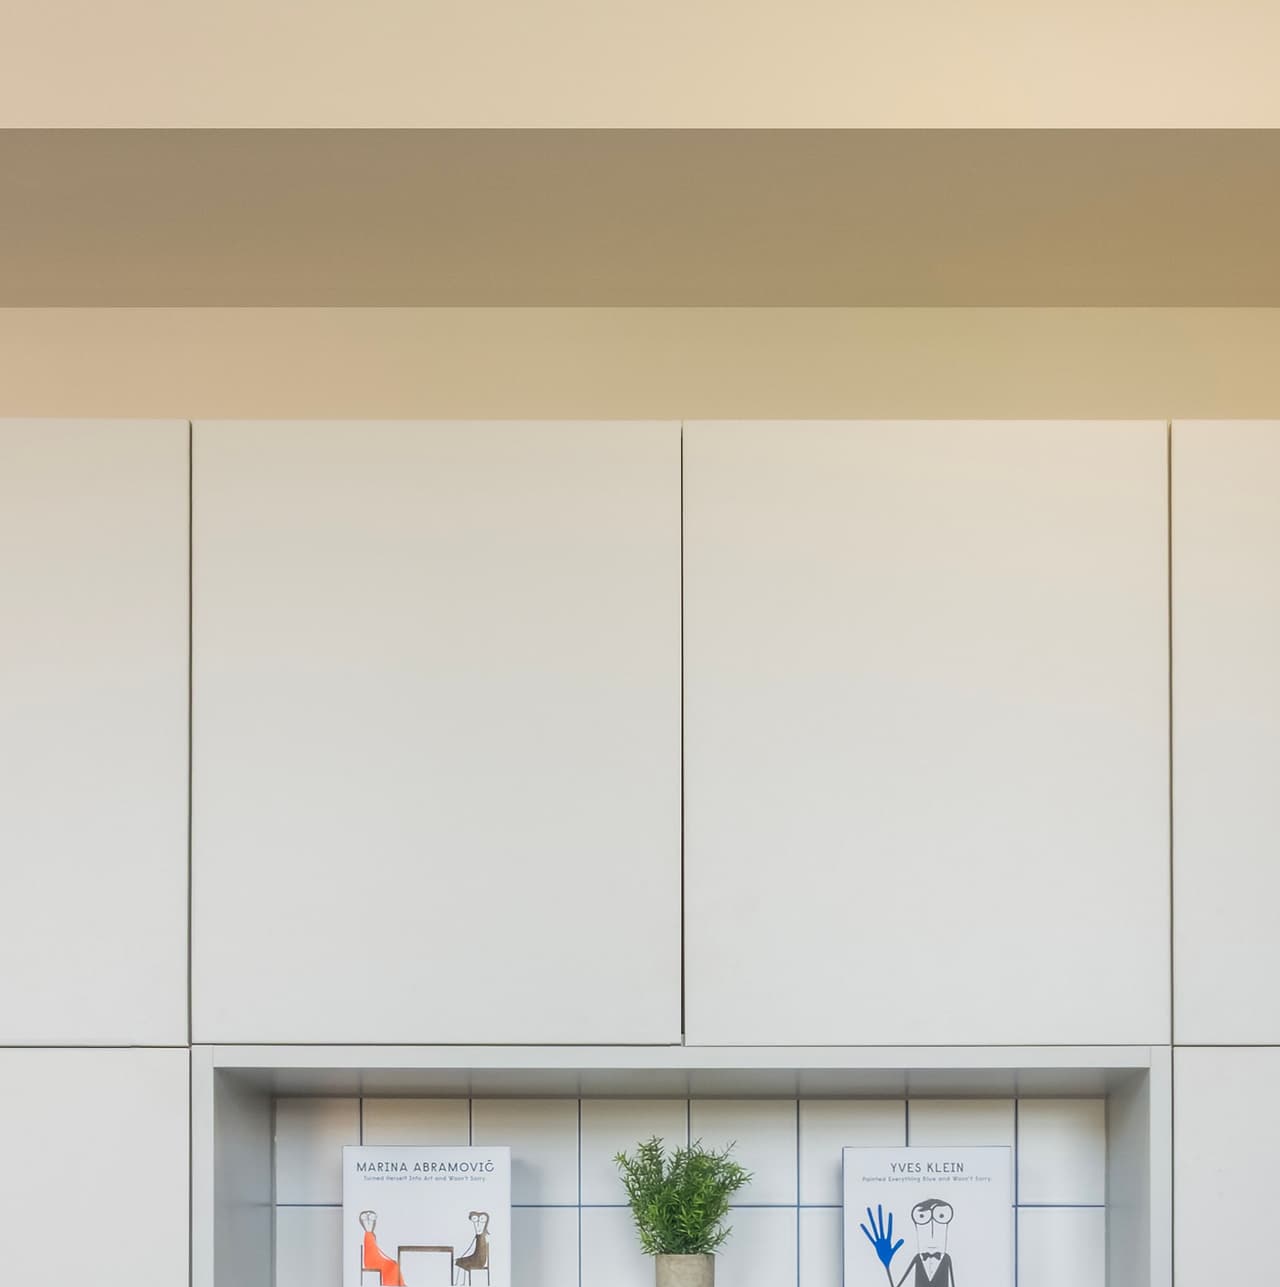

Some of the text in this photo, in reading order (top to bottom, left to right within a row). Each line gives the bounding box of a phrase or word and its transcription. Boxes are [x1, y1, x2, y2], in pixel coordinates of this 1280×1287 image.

[356, 1159, 495, 1172] MARINA ABRAMOVIĆ
[890, 1162, 964, 1173] YVES KLEIN
